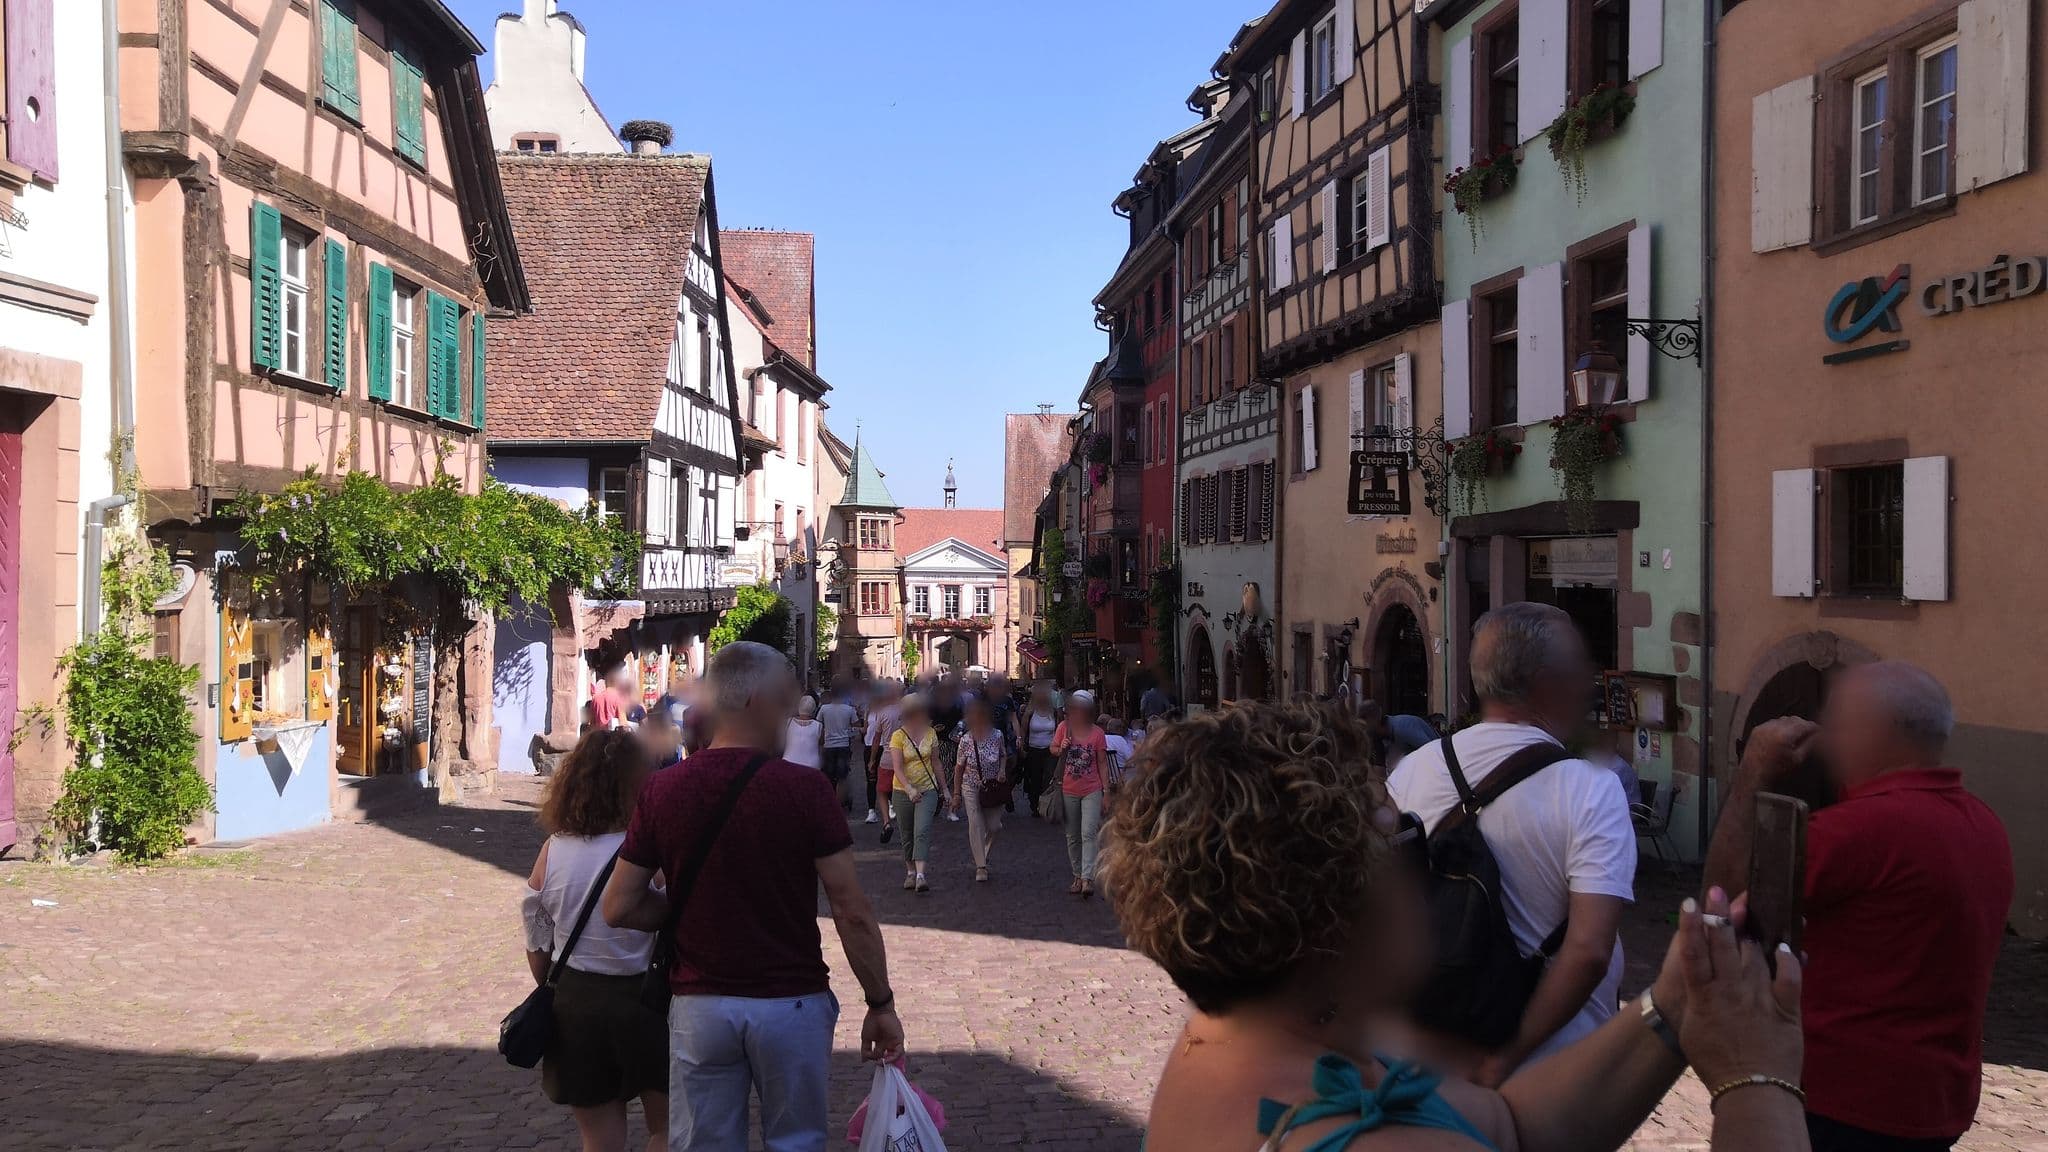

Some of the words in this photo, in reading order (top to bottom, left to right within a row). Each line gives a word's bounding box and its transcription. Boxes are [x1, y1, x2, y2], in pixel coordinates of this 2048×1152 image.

[1919, 254, 2048, 317] CRÉD
[1357, 453, 1402, 467] Crêperie
[1358, 503, 1400, 512] PRESSOIR
